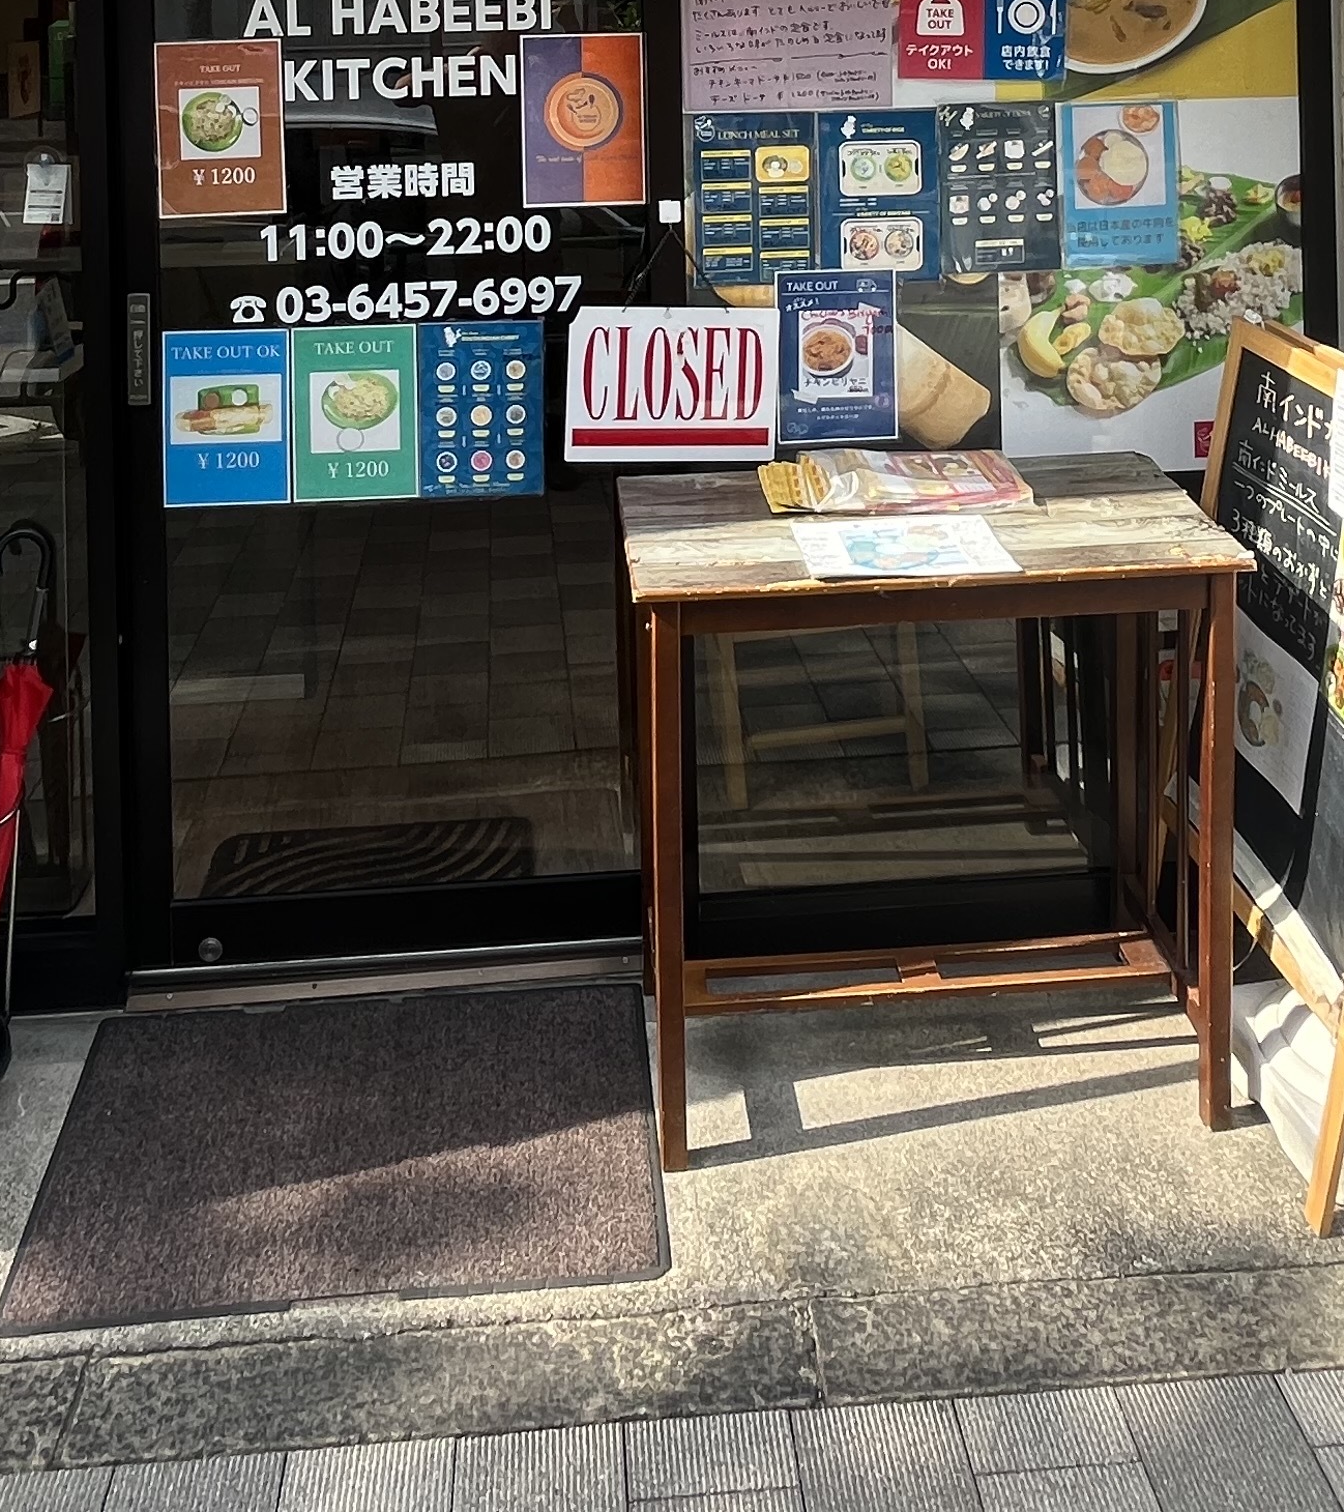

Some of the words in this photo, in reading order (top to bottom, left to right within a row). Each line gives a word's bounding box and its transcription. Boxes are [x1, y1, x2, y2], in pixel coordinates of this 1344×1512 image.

[926, 8, 954, 18] TAKE
[927, 20, 952, 29] OUT
[906, 43, 974, 57] テイクアウト
[1001, 45, 1051, 58] 店内飲食
[199, 65, 221, 73] TAKE
[222, 64, 241, 73] OUT
[927, 58, 952, 70] OK!
[284, 53, 518, 103] KITCHEN
[782, 129, 800, 138] SET
[192, 169, 206, 185] ¥
[211, 167, 256, 185] 1200
[330, 162, 476, 200] 営業時間
[787, 282, 812, 292] TAKE
[816, 280, 838, 291] OUT
[276, 275, 582, 324] 03-6457-6997
[171, 346, 213, 361] TAKE
[217, 345, 253, 359] OUT
[256, 344, 281, 358] OK
[314, 341, 355, 356] TAKE
[359, 340, 395, 354] OUT
[582, 326, 763, 420] CLOSED
[804, 377, 867, 388] チキンビリヤニ
[197, 453, 210, 470] ¥
[216, 451, 260, 469] 1200
[327, 462, 340, 479] ¥
[346, 461, 389, 478] 1200
